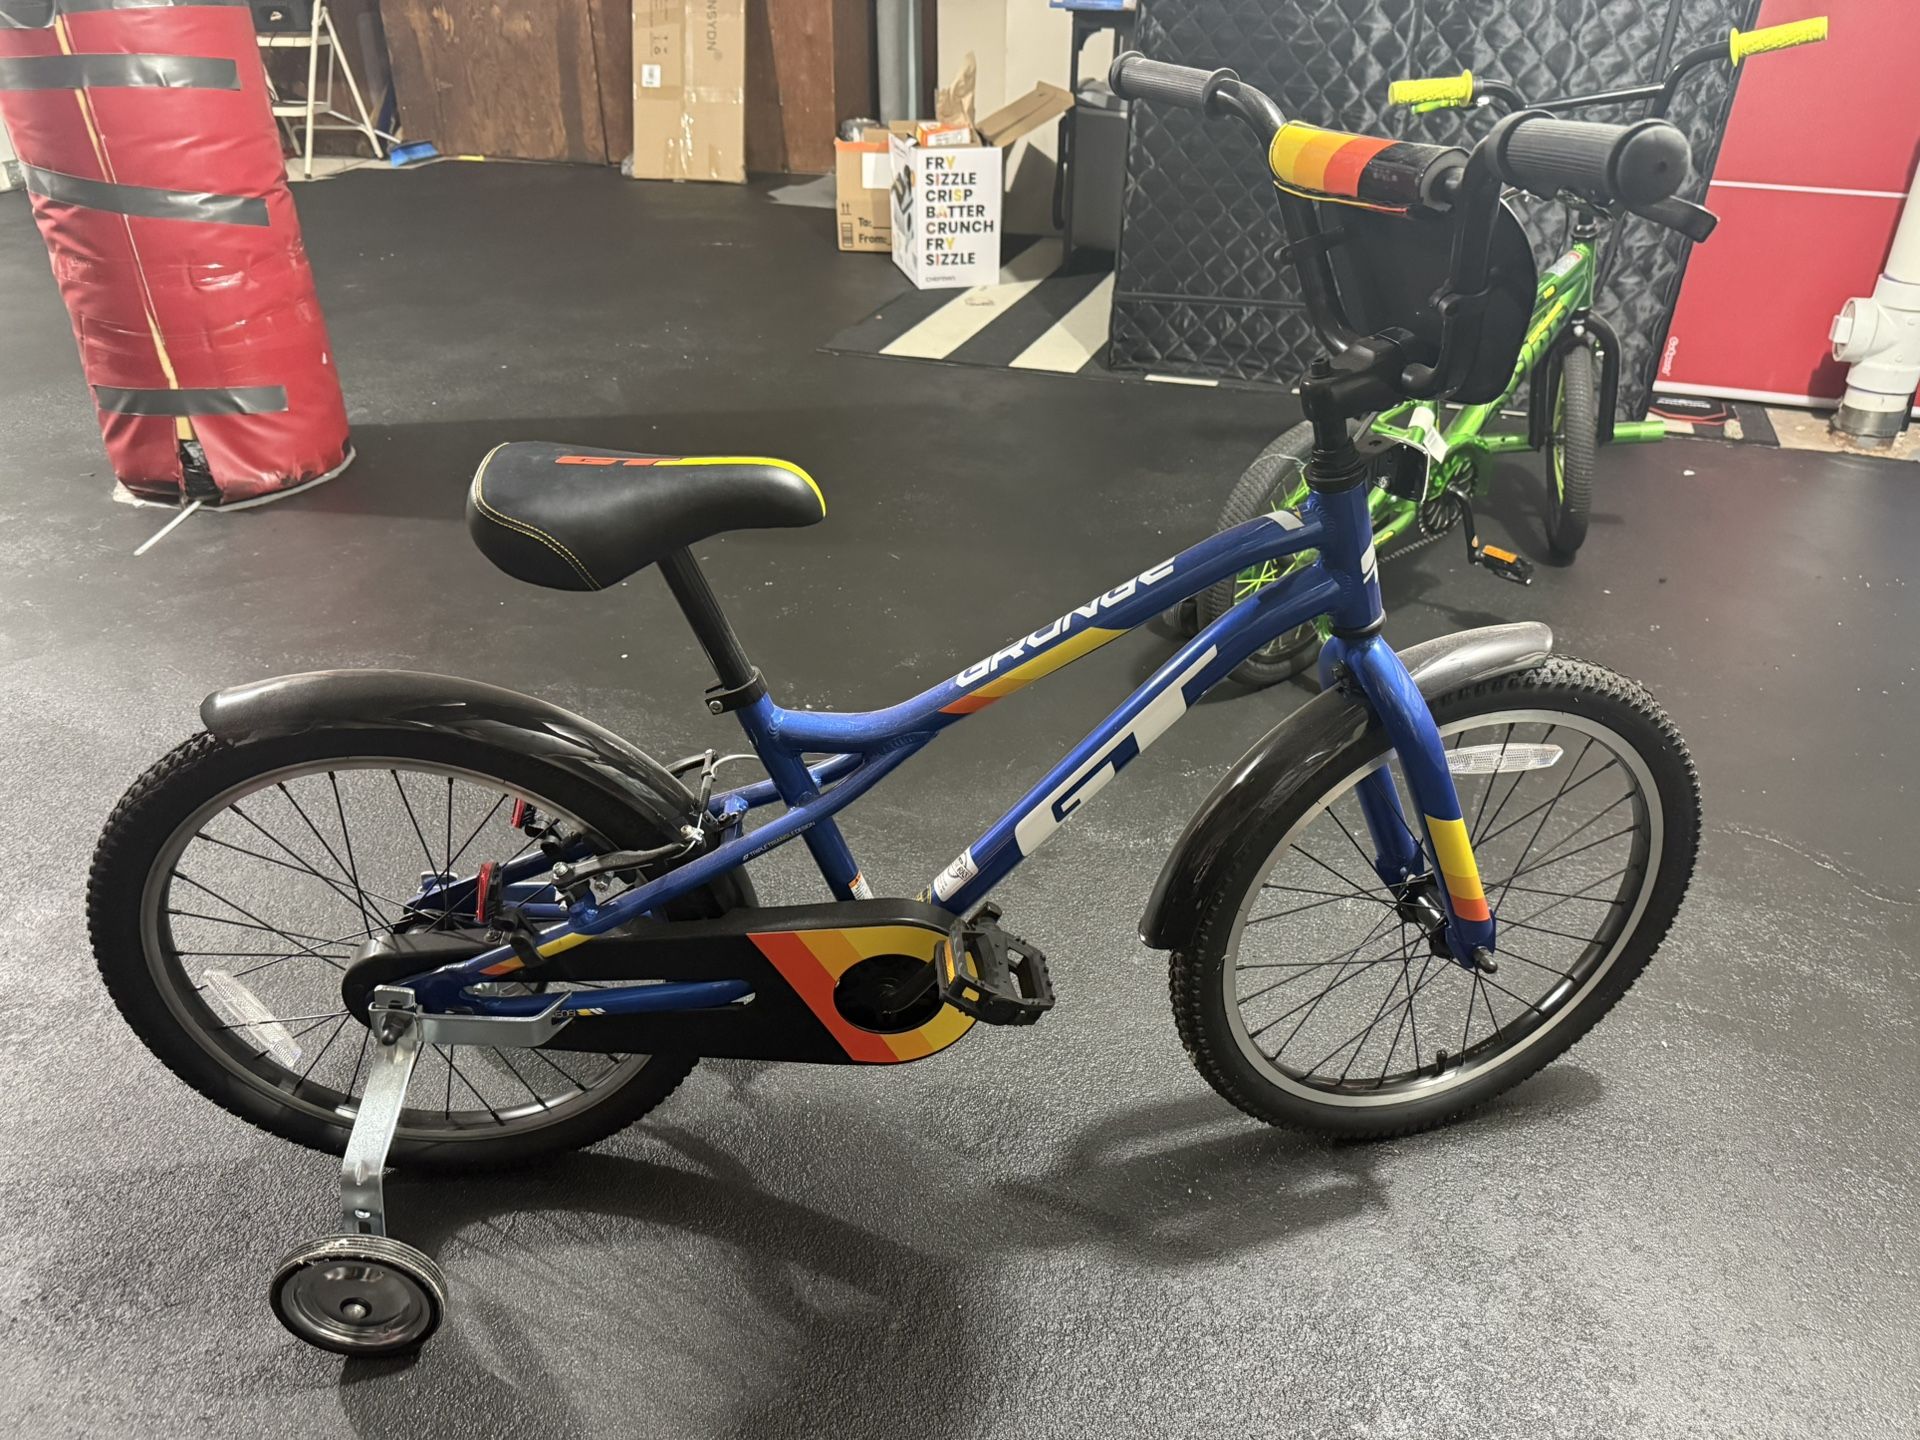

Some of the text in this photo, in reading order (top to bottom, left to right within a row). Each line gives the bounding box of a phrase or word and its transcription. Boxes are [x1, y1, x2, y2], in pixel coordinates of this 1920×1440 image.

[926, 156, 955, 169] FRY
[925, 172, 977, 186] SIZZLE
[925, 188, 974, 202] CRISP
[926, 204, 985, 218] BATTER
[926, 220, 994, 234] CRUNCH
[926, 237, 956, 250] FRY
[925, 252, 976, 266] SIZZLE
[955, 556, 1176, 689] GRUNGE
[1014, 643, 1219, 858] GT
[749, 842, 769, 857] TRIPLE
[795, 821, 816, 834] DESIGN
